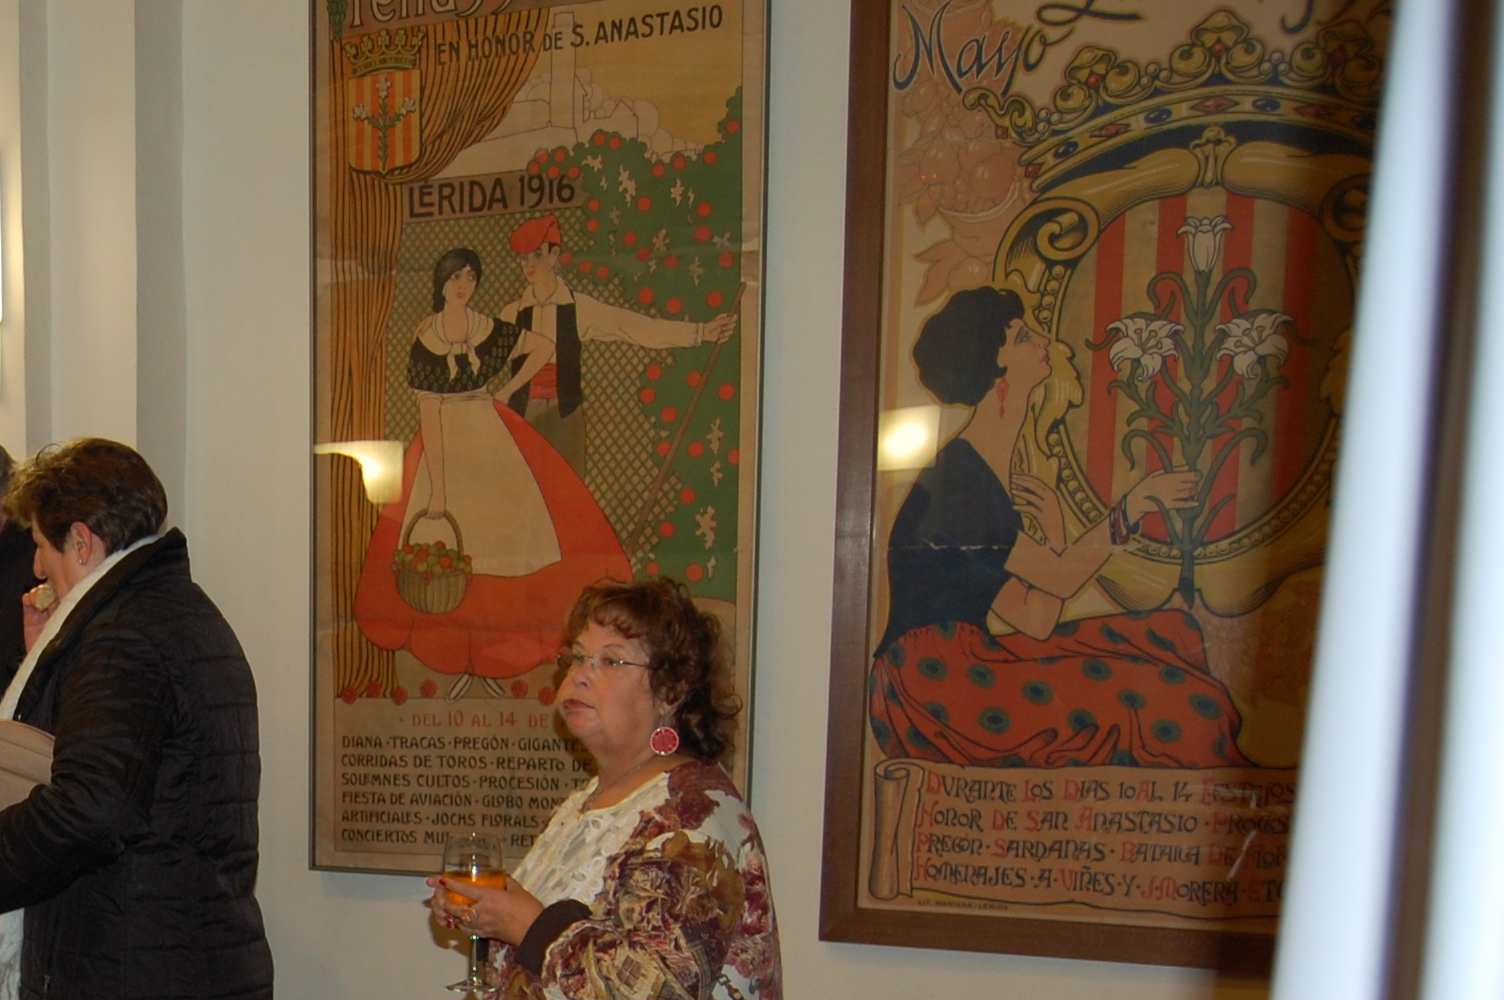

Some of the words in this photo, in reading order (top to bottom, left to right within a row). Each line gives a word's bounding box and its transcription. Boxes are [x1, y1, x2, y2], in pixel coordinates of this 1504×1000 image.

[437, 42, 462, 66] EN
[468, 30, 534, 64] HONOR
[542, 32, 565, 52] DE
[570, 25, 591, 49] S.
[594, 4, 723, 45] ANASTASIO
[893, 0, 1073, 96] Mayo
[408, 178, 508, 219] LÉRIDA
[519, 175, 575, 208] 1916
[412, 713, 441, 728] DEL
[447, 710, 464, 726] 10
[471, 713, 491, 728] AL
[499, 712, 517, 727] 14
[528, 714, 548, 729] DE
[342, 736, 382, 749] DIANA
[389, 736, 445, 749] TRACAS
[453, 734, 509, 751] PREGÓN
[341, 754, 408, 768] CORRIDAS
[413, 755, 432, 769] DE
[437, 756, 487, 770] TOROS
[496, 757, 565, 772] REPARTO
[571, 758, 592, 773] DE
[341, 773, 410, 788] SOLEMNES
[416, 775, 470, 789] CULTOS
[479, 773, 559, 790] PROCESIÓN
[926, 771, 1017, 804] DURANTE
[1063, 778, 1111, 802] DIAS
[1118, 781, 1136, 800] 10
[1173, 780, 1193, 803] 14
[342, 791, 386, 805] FIESTA
[390, 793, 405, 806] DE
[410, 791, 472, 807] AVIACIÓN
[482, 794, 523, 808] GLOBO
[342, 811, 422, 825] ARTIFICIALES
[431, 812, 475, 827] JOCHS
[482, 813, 539, 829] FLORALS
[918, 800, 984, 833] HONOR
[991, 809, 1019, 831] DE
[1022, 809, 1069, 832] SAN
[1074, 806, 1198, 834] ANASTASIO
[341, 829, 417, 844] CONCIERTOS
[991, 838, 1106, 863] SARDANAS
[914, 856, 1027, 889] HOMENAJES
[1060, 866, 1115, 896] VIÑES
